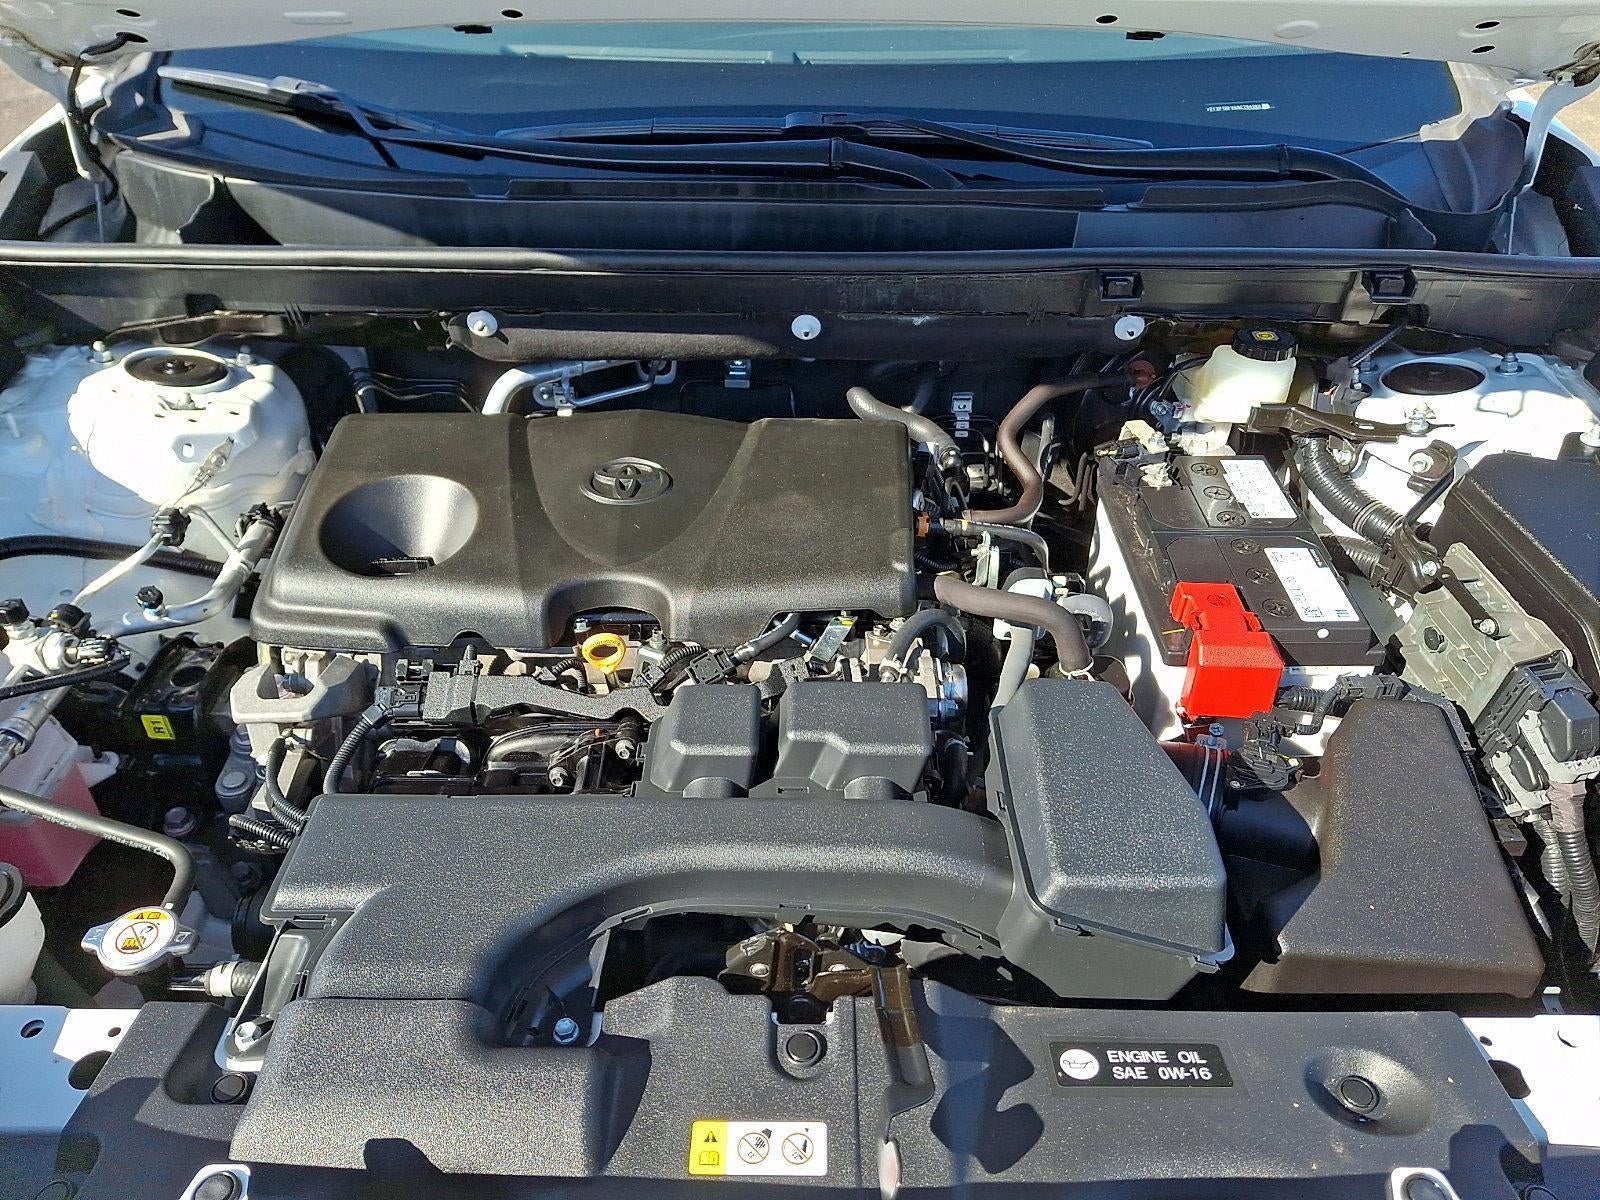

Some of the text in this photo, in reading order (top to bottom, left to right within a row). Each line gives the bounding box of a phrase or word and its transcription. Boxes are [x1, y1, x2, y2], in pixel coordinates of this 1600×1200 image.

[1106, 1050, 1208, 1065] ENGINE OIL
[1112, 1066, 1213, 1081] SAE 0W-16
